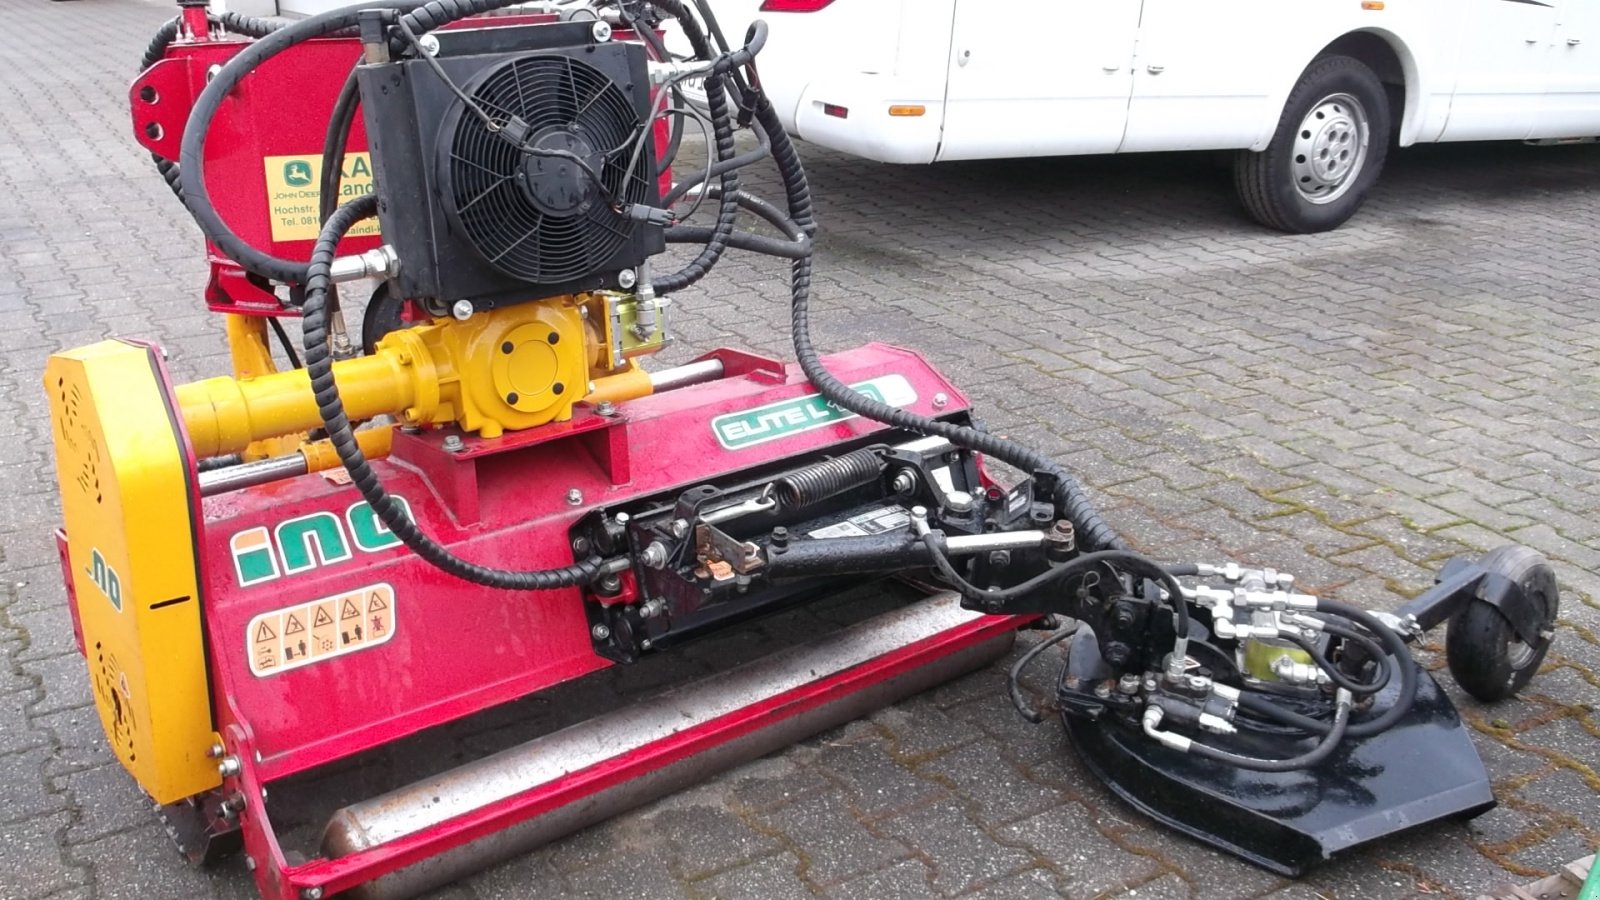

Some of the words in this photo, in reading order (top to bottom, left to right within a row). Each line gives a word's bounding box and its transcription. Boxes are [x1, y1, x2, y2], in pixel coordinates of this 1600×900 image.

[274, 205, 315, 214] Hochstr.
[281, 218, 299, 226] Tel.
[720, 406, 808, 441] ELITE
[806, 403, 830, 420] L
